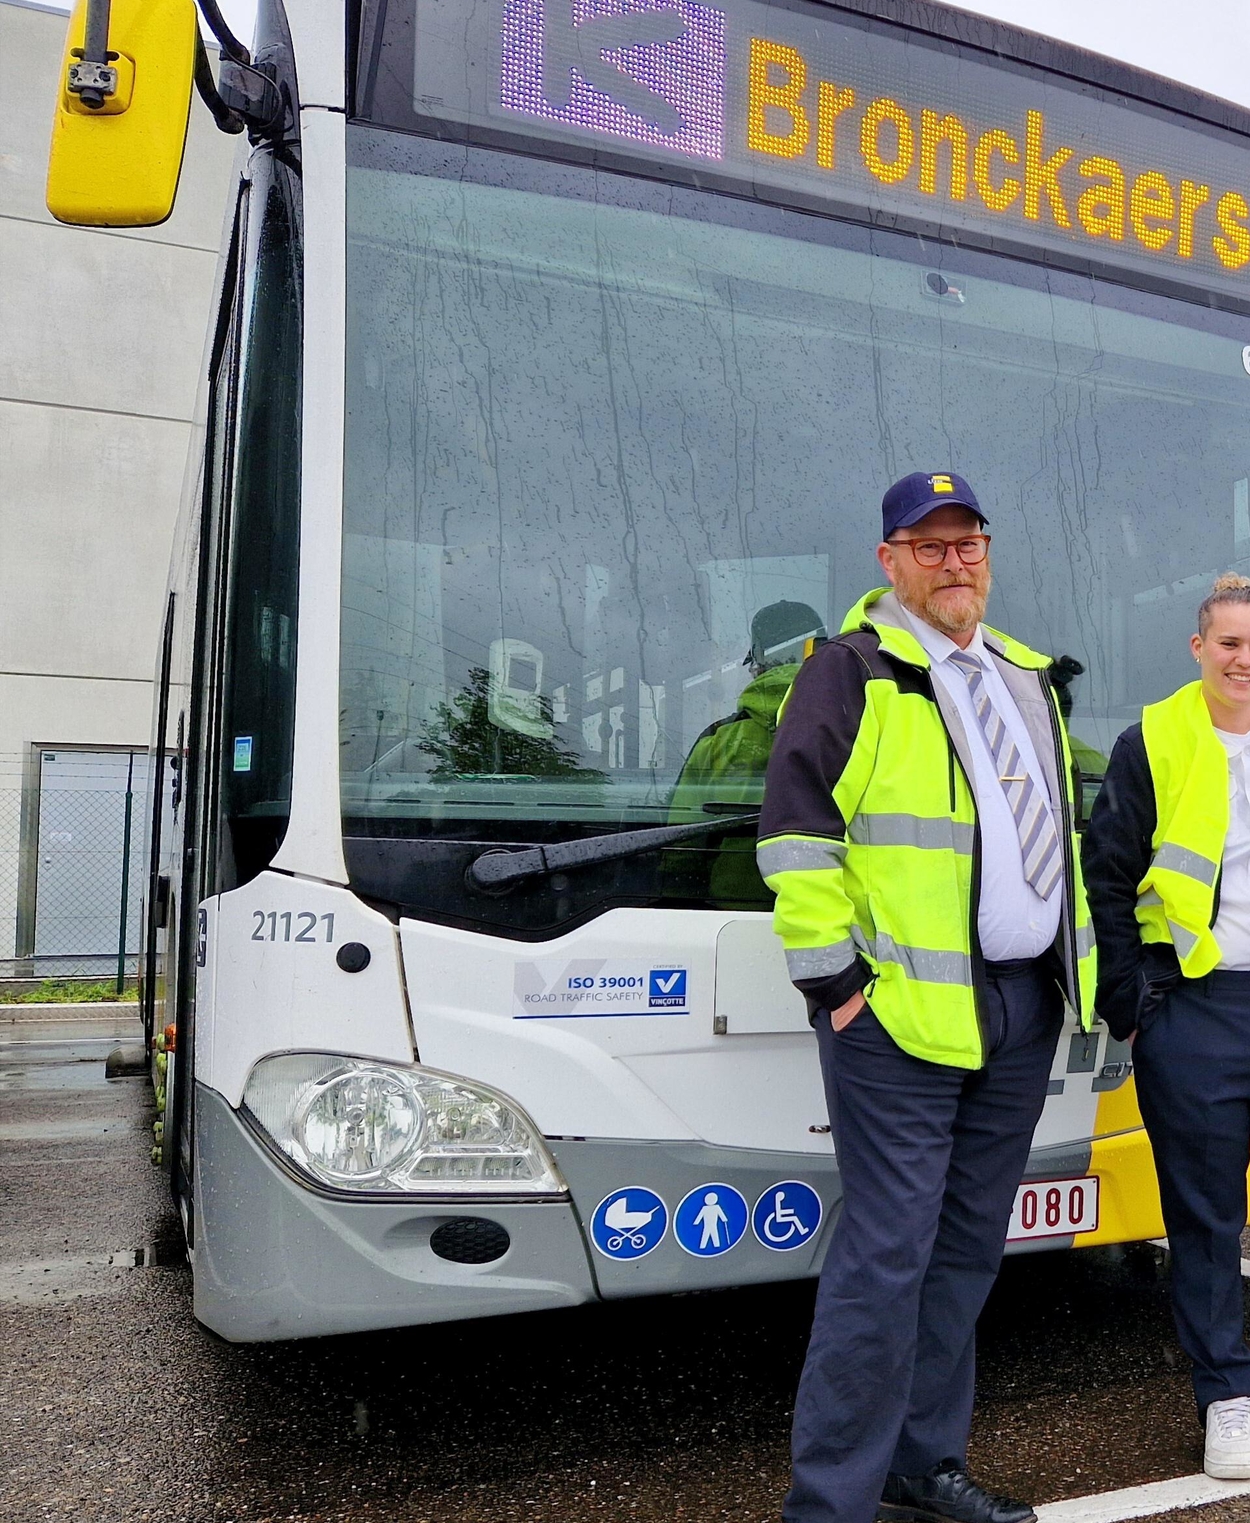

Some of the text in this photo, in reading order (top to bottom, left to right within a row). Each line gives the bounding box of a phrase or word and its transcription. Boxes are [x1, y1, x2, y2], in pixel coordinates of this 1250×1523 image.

[541, 0, 691, 136] K
[251, 910, 335, 943] 21121
[568, 976, 644, 989] ISO 39001
[524, 991, 643, 1003] ROAD TRAFFIC SAFETY
